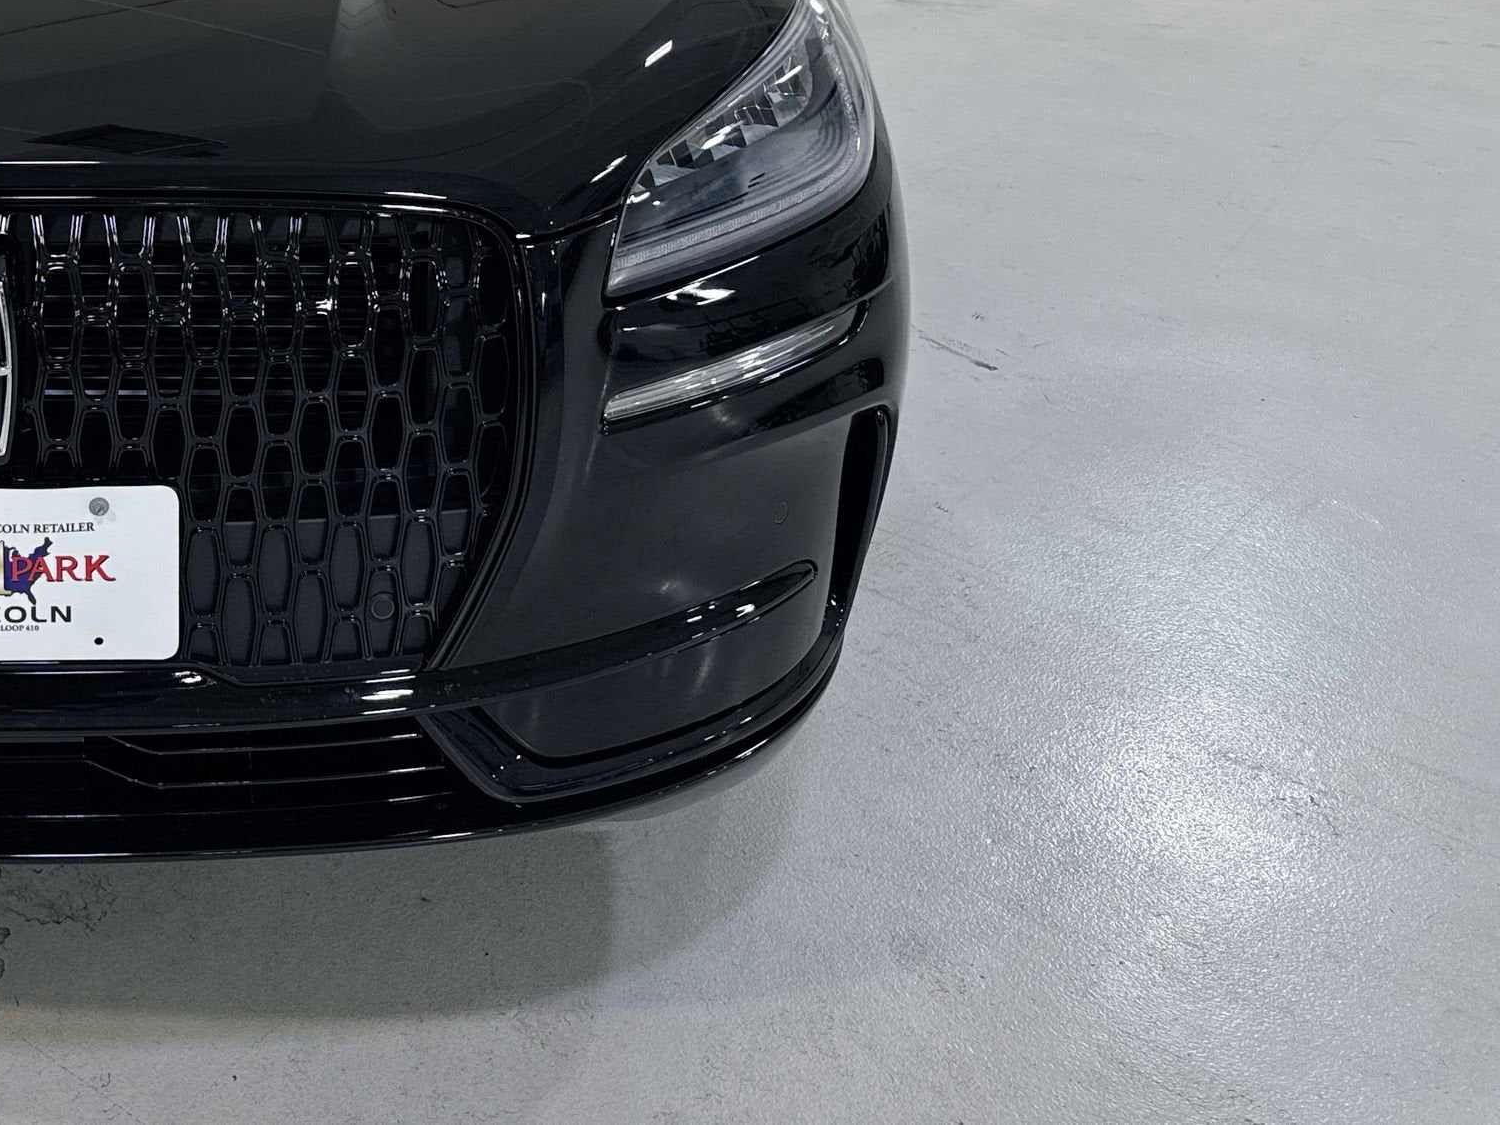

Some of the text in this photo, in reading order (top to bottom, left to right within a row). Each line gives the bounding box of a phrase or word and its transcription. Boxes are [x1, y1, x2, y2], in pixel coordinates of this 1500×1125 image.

[33, 521, 96, 534] RETAILER
[10, 554, 117, 583] PARK
[0, 624, 25, 632] LOOP
[25, 624, 40, 632] 410
